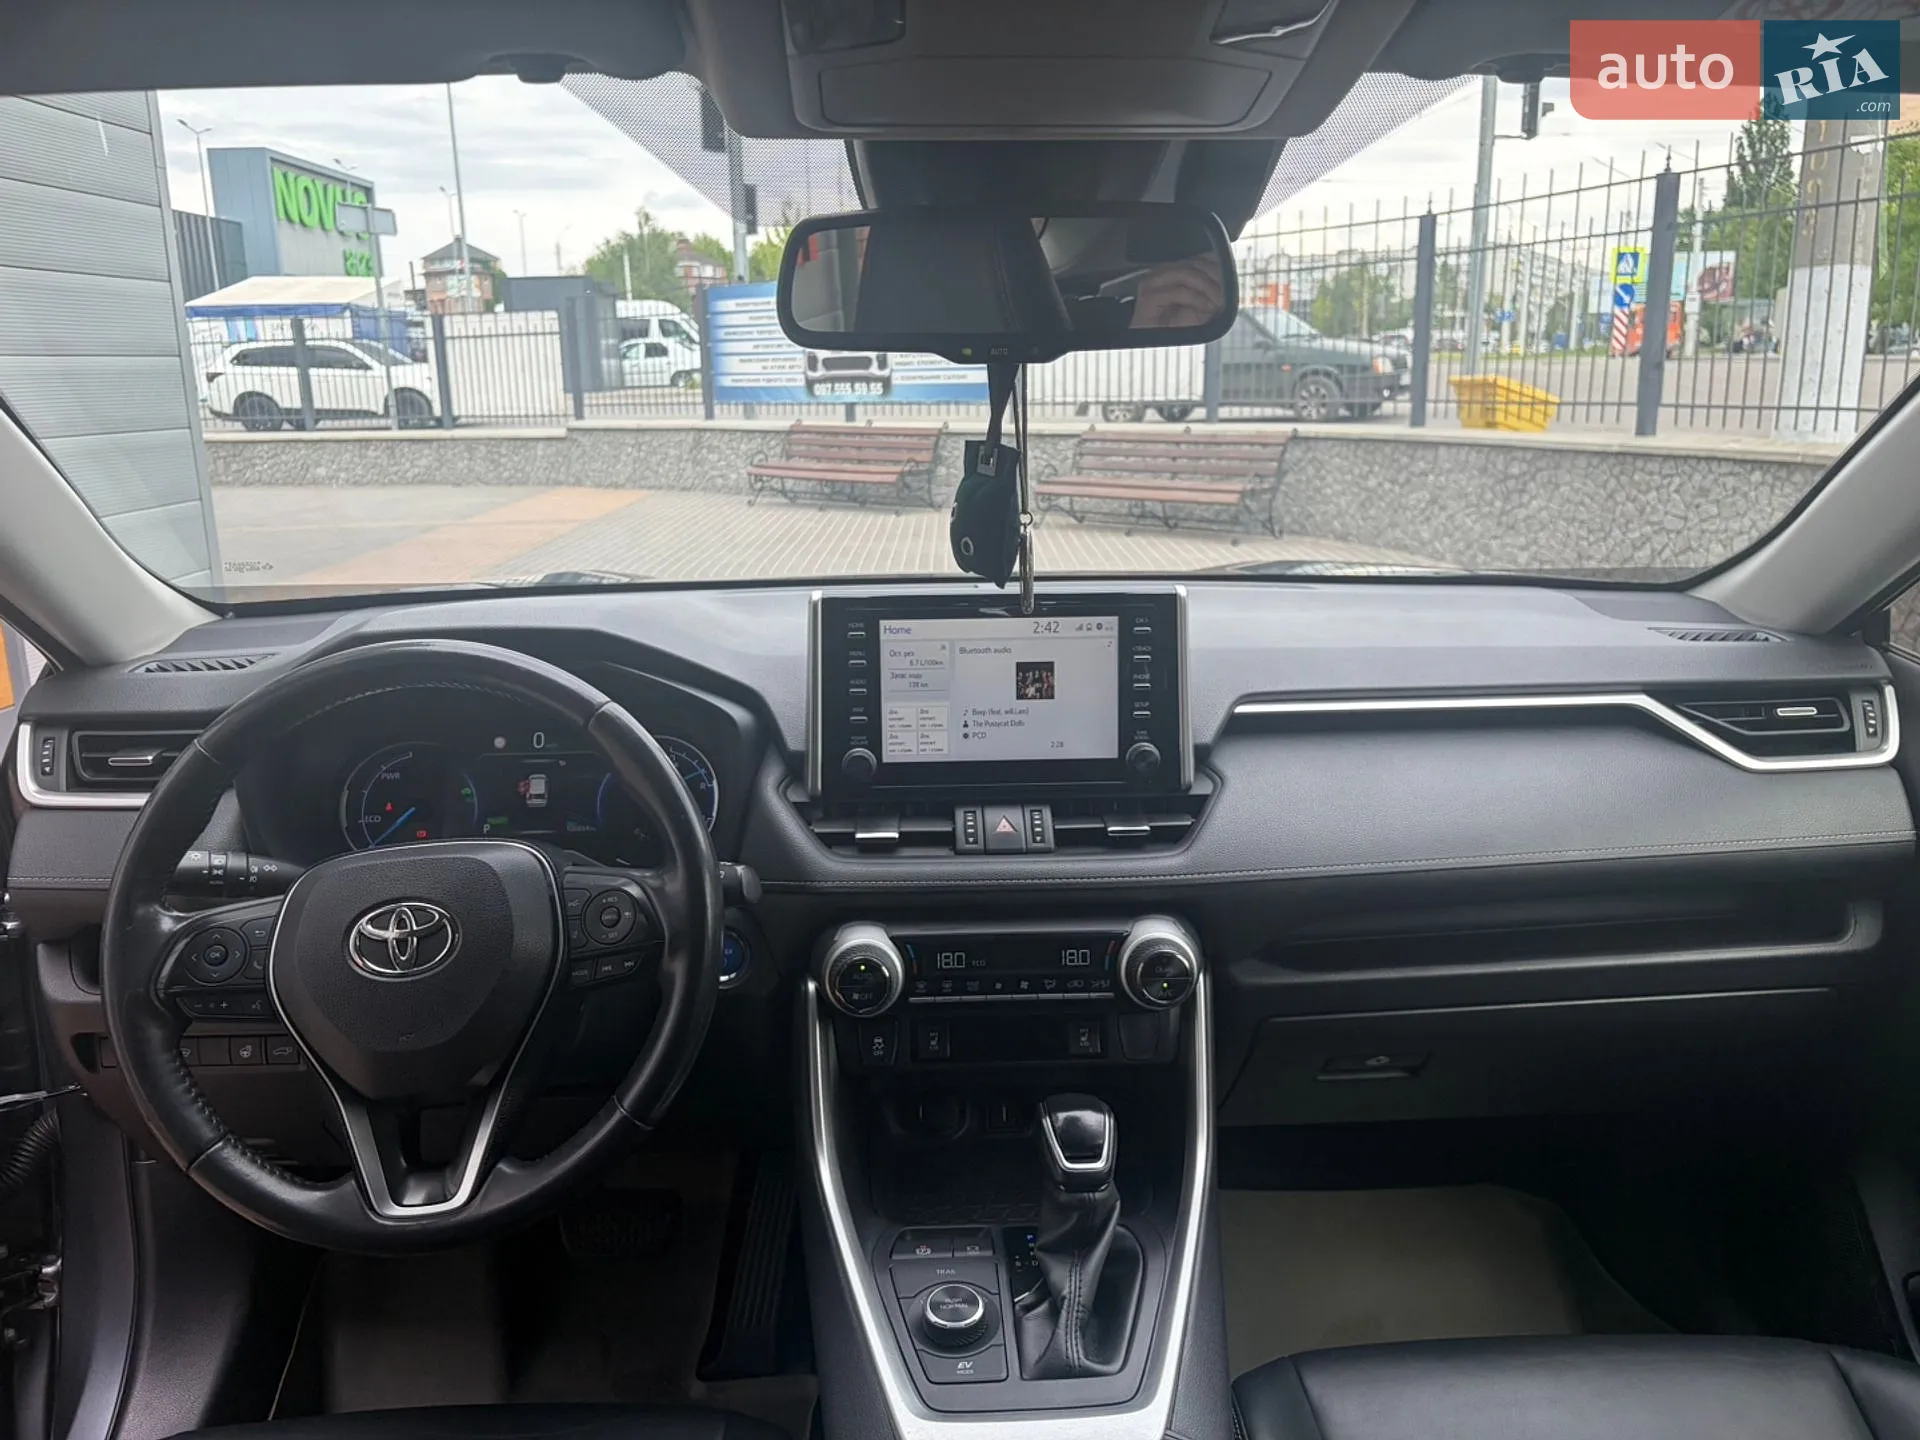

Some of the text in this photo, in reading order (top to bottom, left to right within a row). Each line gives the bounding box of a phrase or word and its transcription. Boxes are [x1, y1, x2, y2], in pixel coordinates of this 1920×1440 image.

[990, 347, 1008, 355] AUTO
[883, 624, 913, 635] Home
[1032, 620, 1060, 634] 2:42
[958, 646, 1012, 655] Bluetooth audio
[533, 731, 545, 748] 0
[381, 772, 400, 780] PWR
[483, 823, 491, 834] P
[937, 952, 965, 969] 18.0
[1061, 950, 1091, 965] 18.0
[957, 1361, 974, 1369] EV
